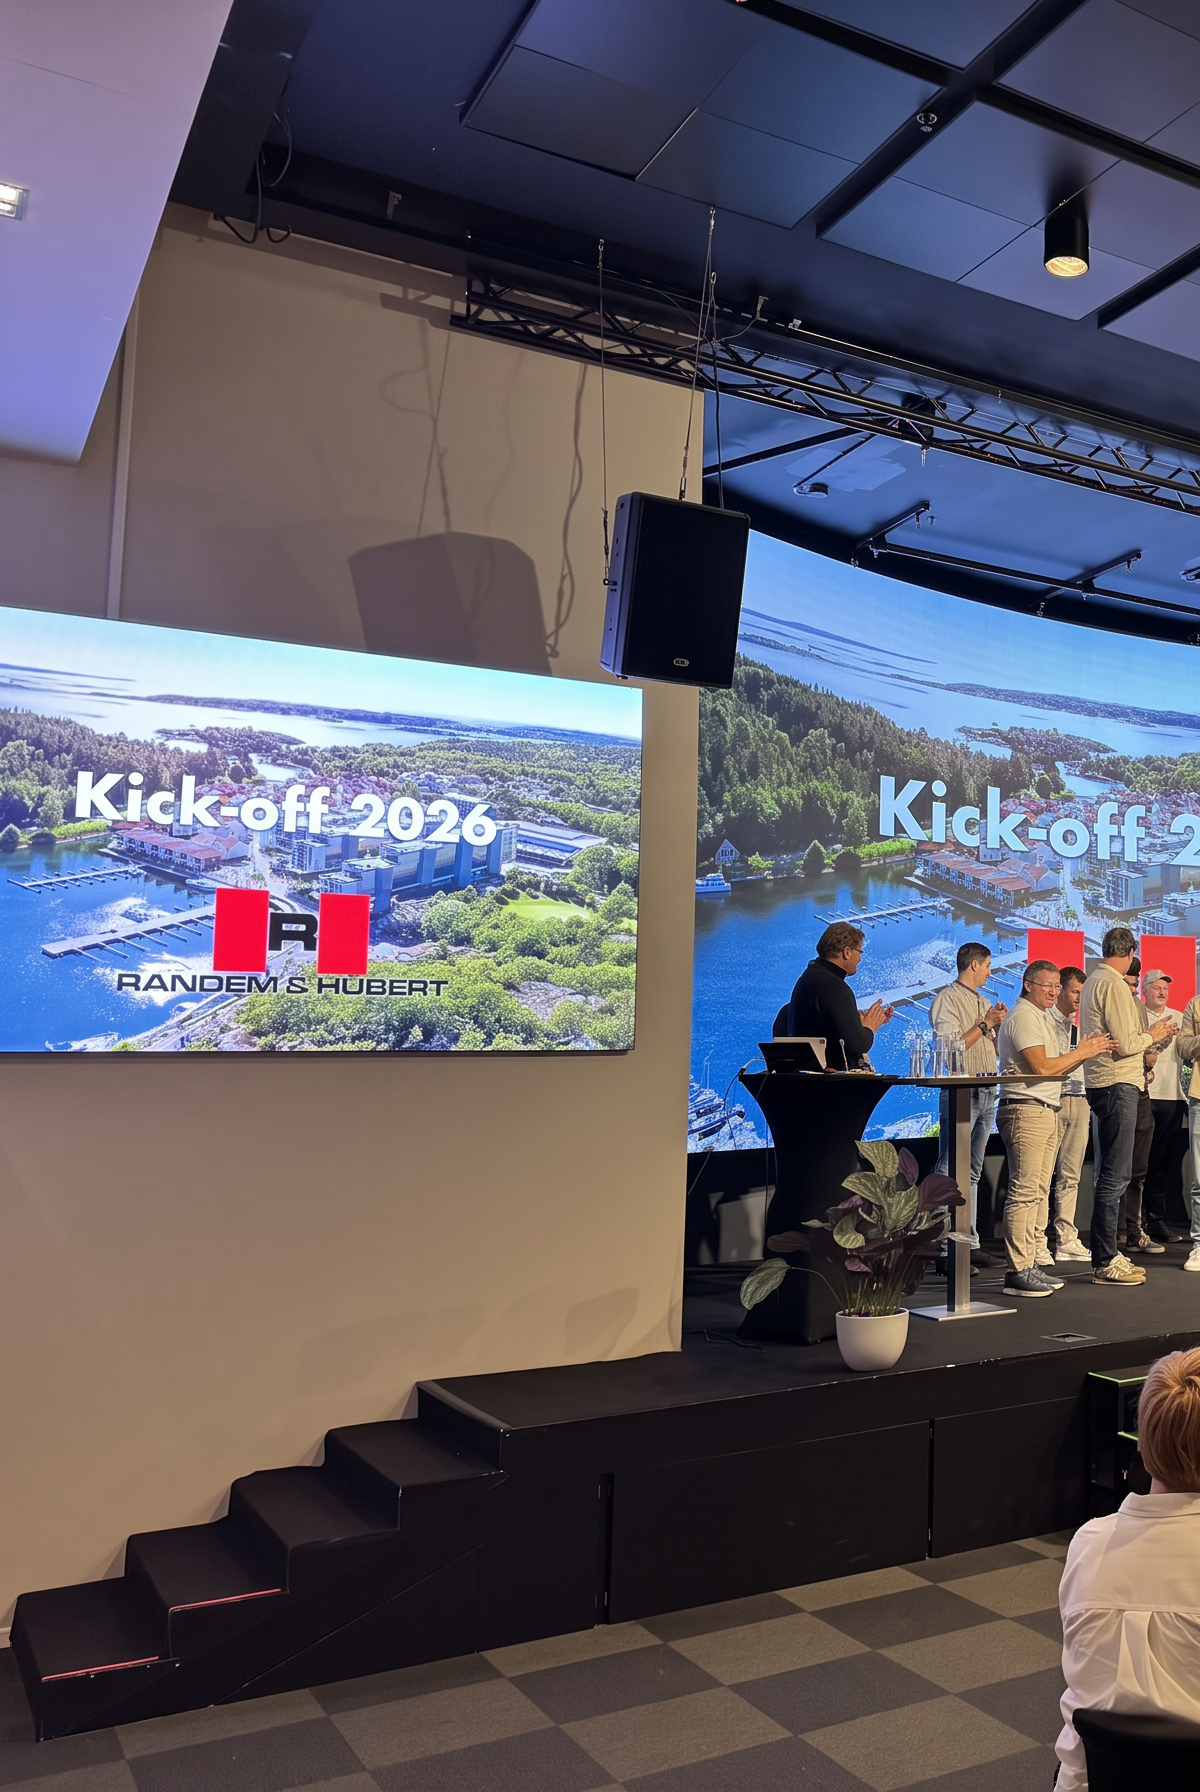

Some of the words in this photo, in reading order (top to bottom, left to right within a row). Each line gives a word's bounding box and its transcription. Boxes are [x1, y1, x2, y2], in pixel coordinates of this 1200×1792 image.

[75, 770, 330, 834] Kick-off
[348, 793, 497, 846] 2026
[879, 775, 1146, 862] Kick-off
[268, 912, 319, 951] R
[116, 973, 278, 993] RANDEM
[286, 976, 309, 994] &
